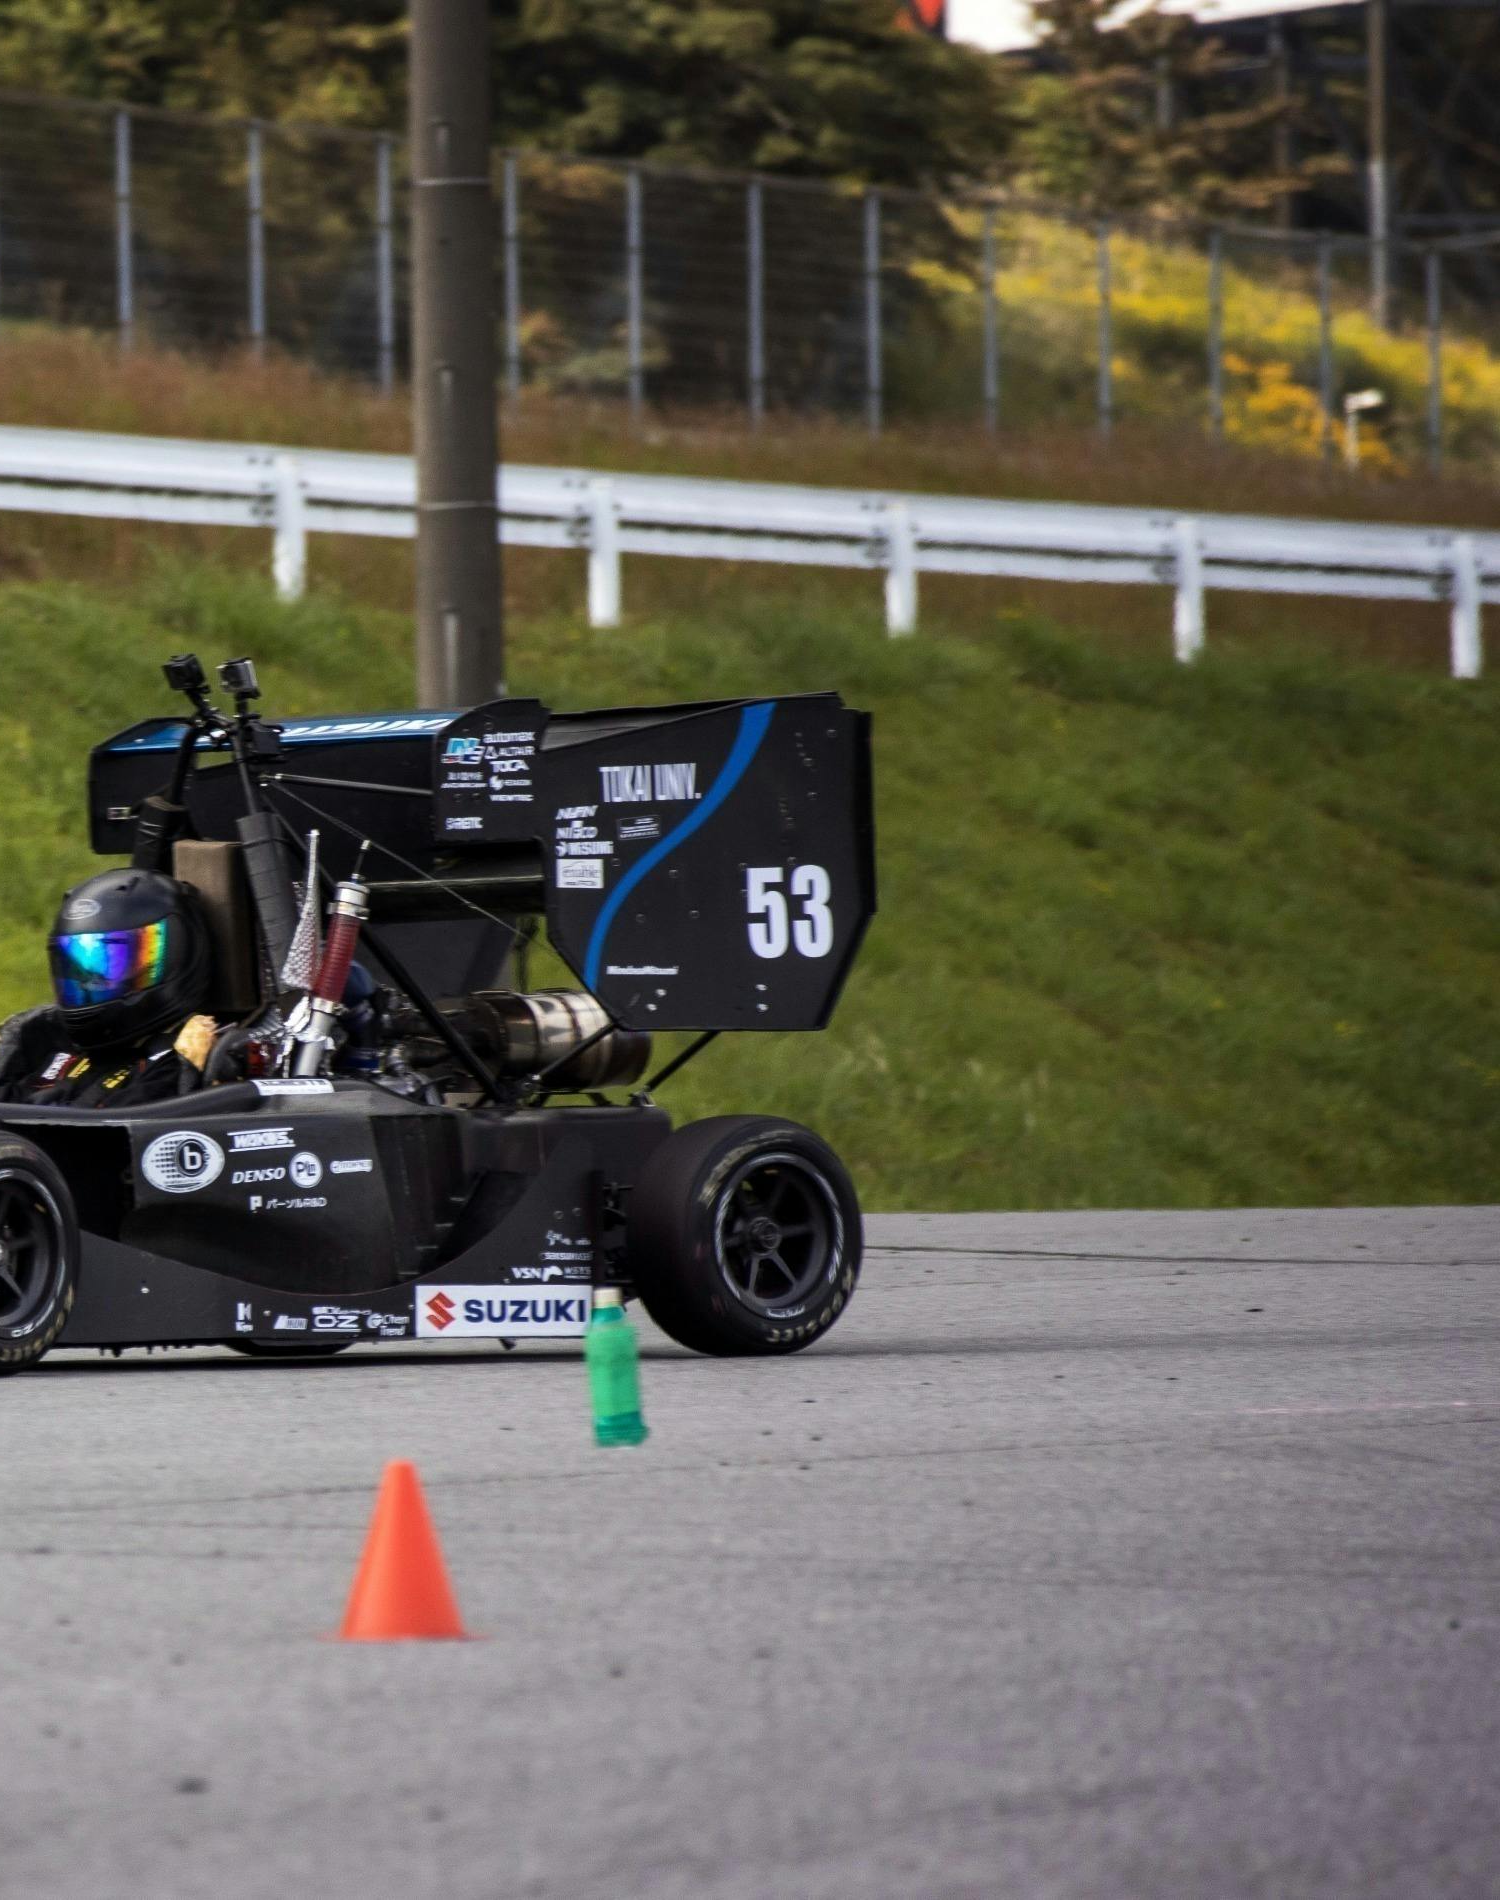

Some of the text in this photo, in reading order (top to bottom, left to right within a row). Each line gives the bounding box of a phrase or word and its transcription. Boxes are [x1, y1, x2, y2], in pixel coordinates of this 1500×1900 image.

[599, 763, 702, 802] TOKAI UNIV.
[746, 864, 834, 959] 53
[232, 1167, 286, 1184] DENSO
[314, 1315, 359, 1328] OZ
[464, 1298, 587, 1322] SUZUKI
